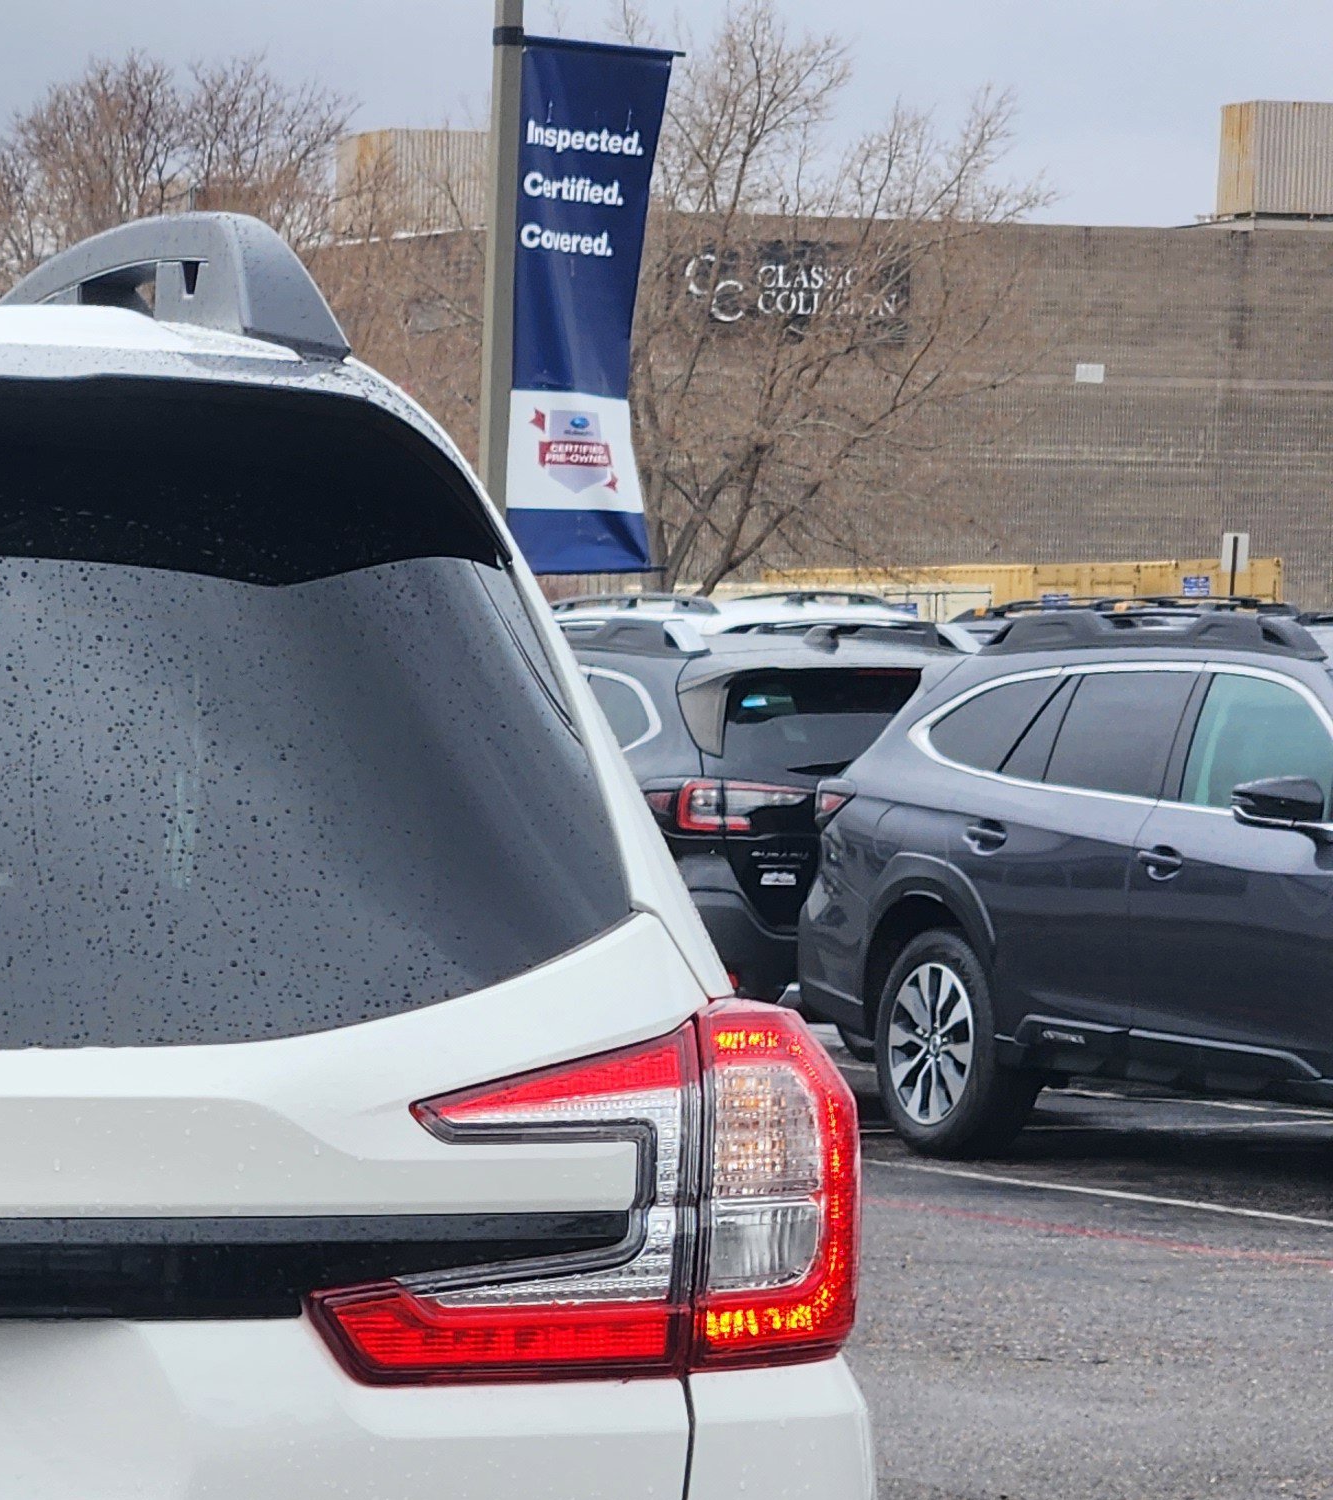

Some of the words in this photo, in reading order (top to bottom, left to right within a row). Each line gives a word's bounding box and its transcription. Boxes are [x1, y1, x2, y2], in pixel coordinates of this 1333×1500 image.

[526, 118, 643, 156] Inspected.
[523, 171, 624, 206] Certified.
[520, 223, 612, 257] Covered.
